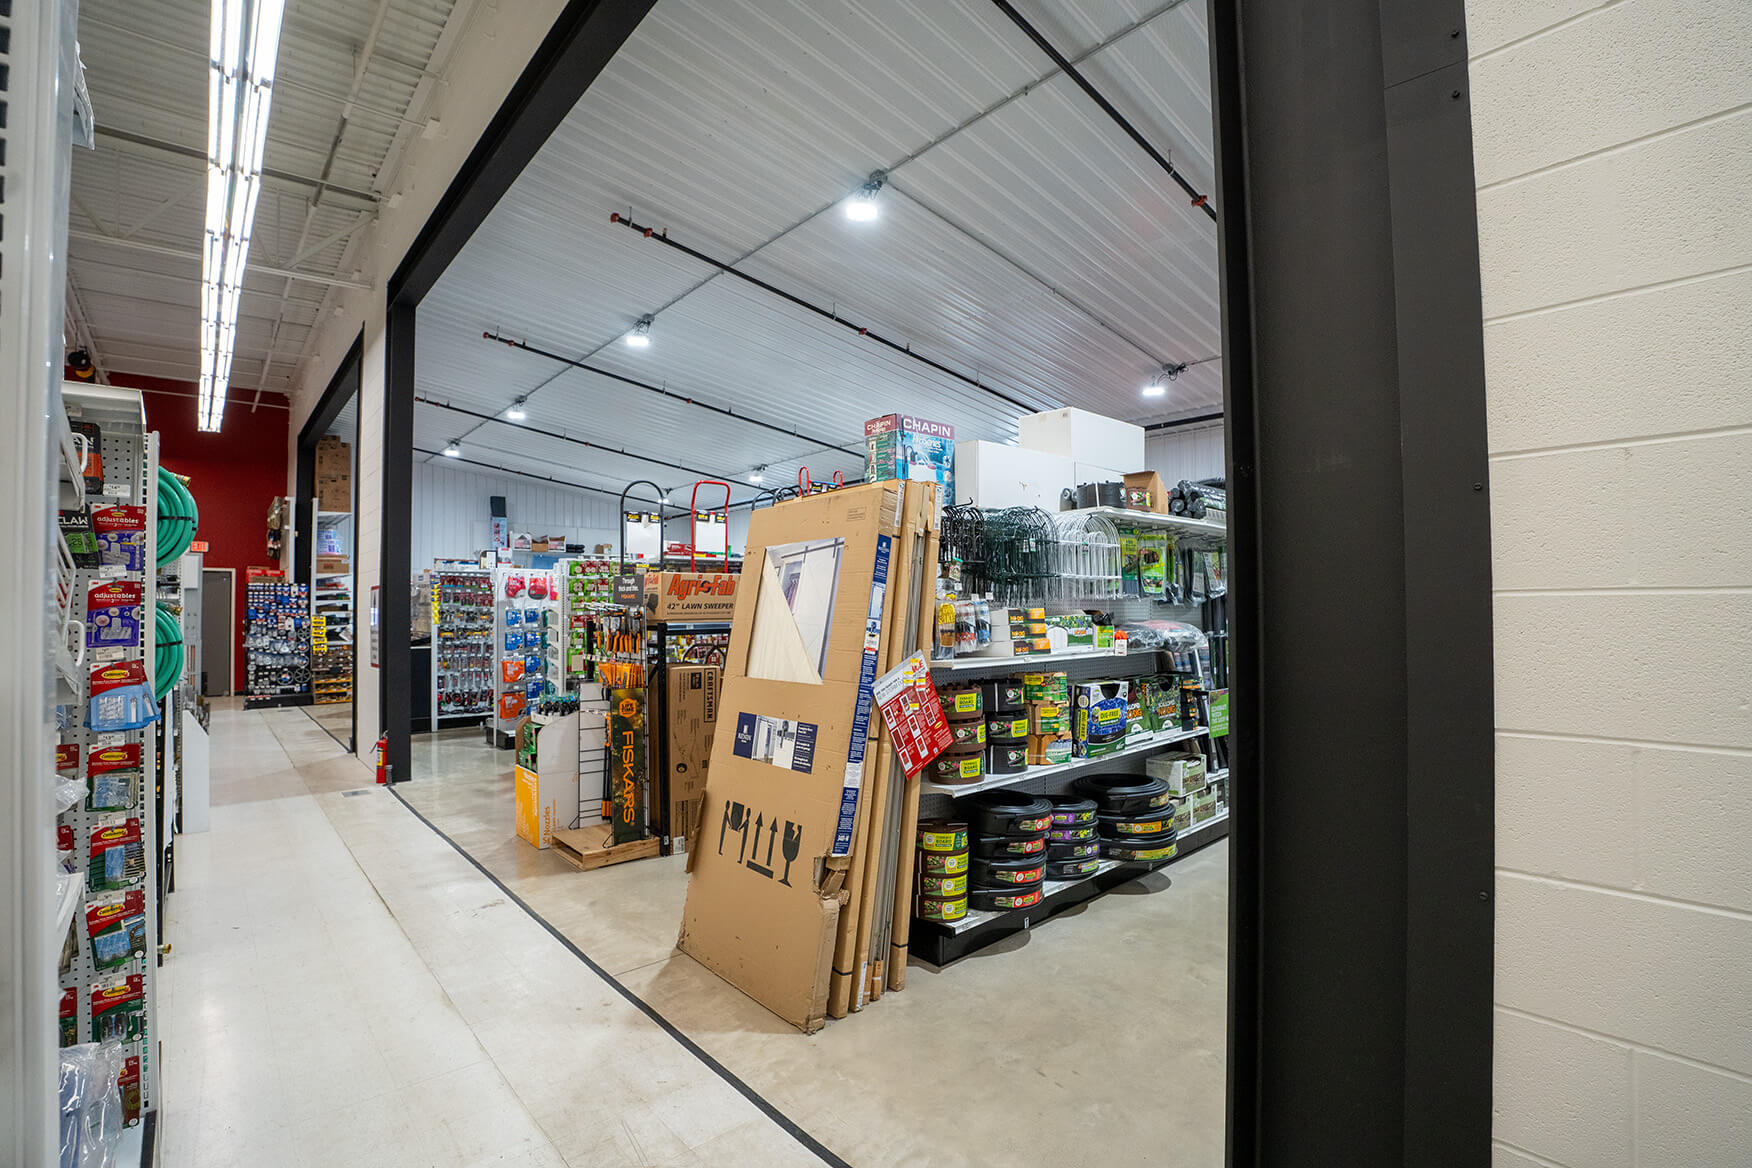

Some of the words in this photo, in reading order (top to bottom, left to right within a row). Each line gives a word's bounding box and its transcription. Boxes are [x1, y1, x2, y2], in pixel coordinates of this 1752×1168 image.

[867, 420, 891, 431] CHAPIN
[903, 418, 951, 437] CHAPIN
[191, 543, 206, 552] EXIT
[682, 602, 702, 610] LAWN
[704, 602, 734, 610] SWEEPER
[622, 730, 635, 824] FISKARS
